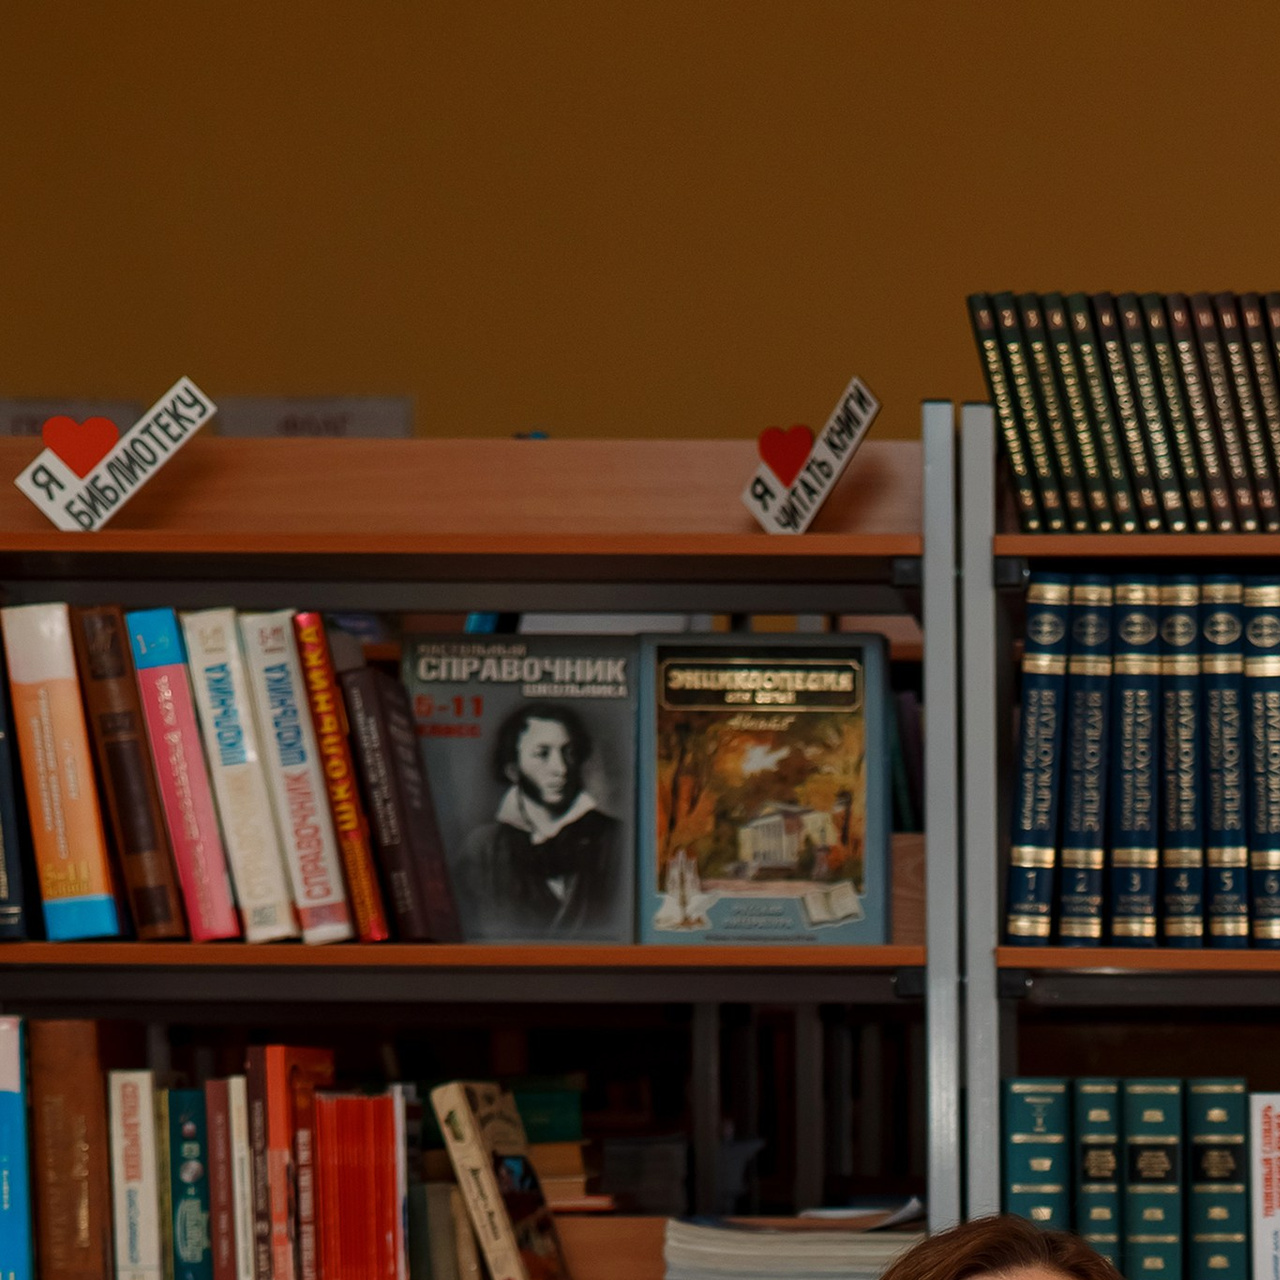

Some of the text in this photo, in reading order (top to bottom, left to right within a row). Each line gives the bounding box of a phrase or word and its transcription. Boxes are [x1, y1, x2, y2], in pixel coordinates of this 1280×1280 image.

[31, 463, 65, 501] Я
[64, 385, 207, 531] БИБЛИОТЕКУ
[750, 477, 775, 511] Я
[774, 384, 872, 532] ЧИТАТЬ КНИГИ
[205, 663, 246, 765] ШКОЛЬНИКА
[264, 663, 307, 766] ШКОЛЬНИКА
[419, 658, 626, 681] СПРАВОЧНИК
[668, 669, 853, 691] ЭНЦИКЛОПЕДИЯ
[301, 625, 357, 831] ШКОЛЬНИКА
[1034, 689, 1056, 831] ЭНЦИКЛОПЕДИЯ
[1082, 691, 1103, 831] ЭНЦИКЛОПЕДИЯ
[1134, 690, 1152, 831] ЭНЦИКЛОПЕДИЯ
[1178, 690, 1196, 831] ЭНЦИКЛОПЕДИЯ
[1221, 689, 1240, 831] ЭНЦИКЛОПЕДИЯ
[284, 768, 331, 899] СПРАВОЧНИК
[1025, 872, 1036, 890] 1
[1074, 872, 1087, 892] 2
[1129, 872, 1141, 892] 3
[1175, 872, 1189, 891] 4
[1221, 870, 1233, 891] 5
[1264, 874, 1279, 894] 6
[1262, 1105, 1275, 1217] ТОЛКОВЫЙ СЛОВАРЬ
